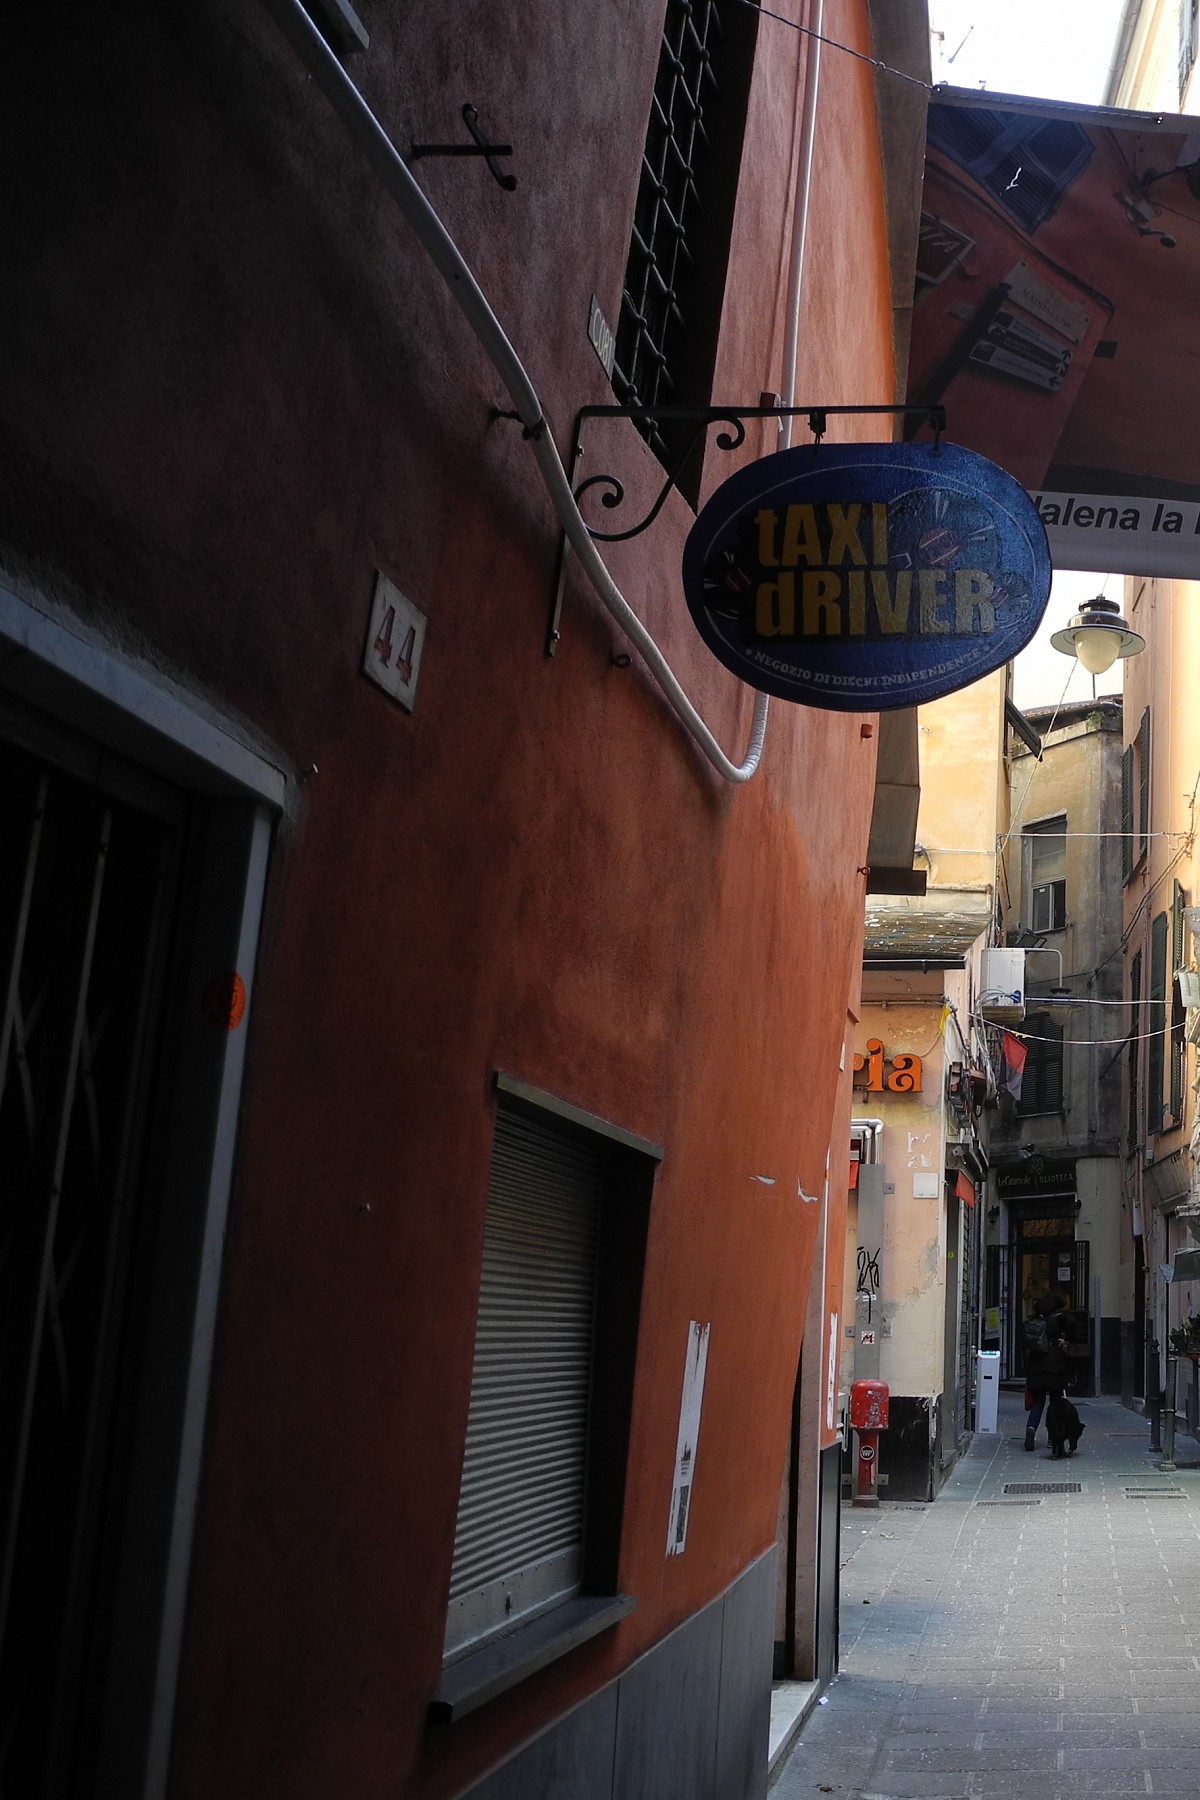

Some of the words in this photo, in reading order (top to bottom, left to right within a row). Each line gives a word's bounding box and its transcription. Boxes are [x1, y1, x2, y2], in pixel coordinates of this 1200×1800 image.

[1151, 503, 1184, 534] la
[373, 604, 416, 688] 44
[754, 650, 811, 680] NEGOZIO
[813, 671, 830, 684] DI
[831, 674, 880, 687] DISCHI
[880, 647, 982, 687] INDIPENDENTE
[1040, 1172, 1074, 1184] OLIOTECA
